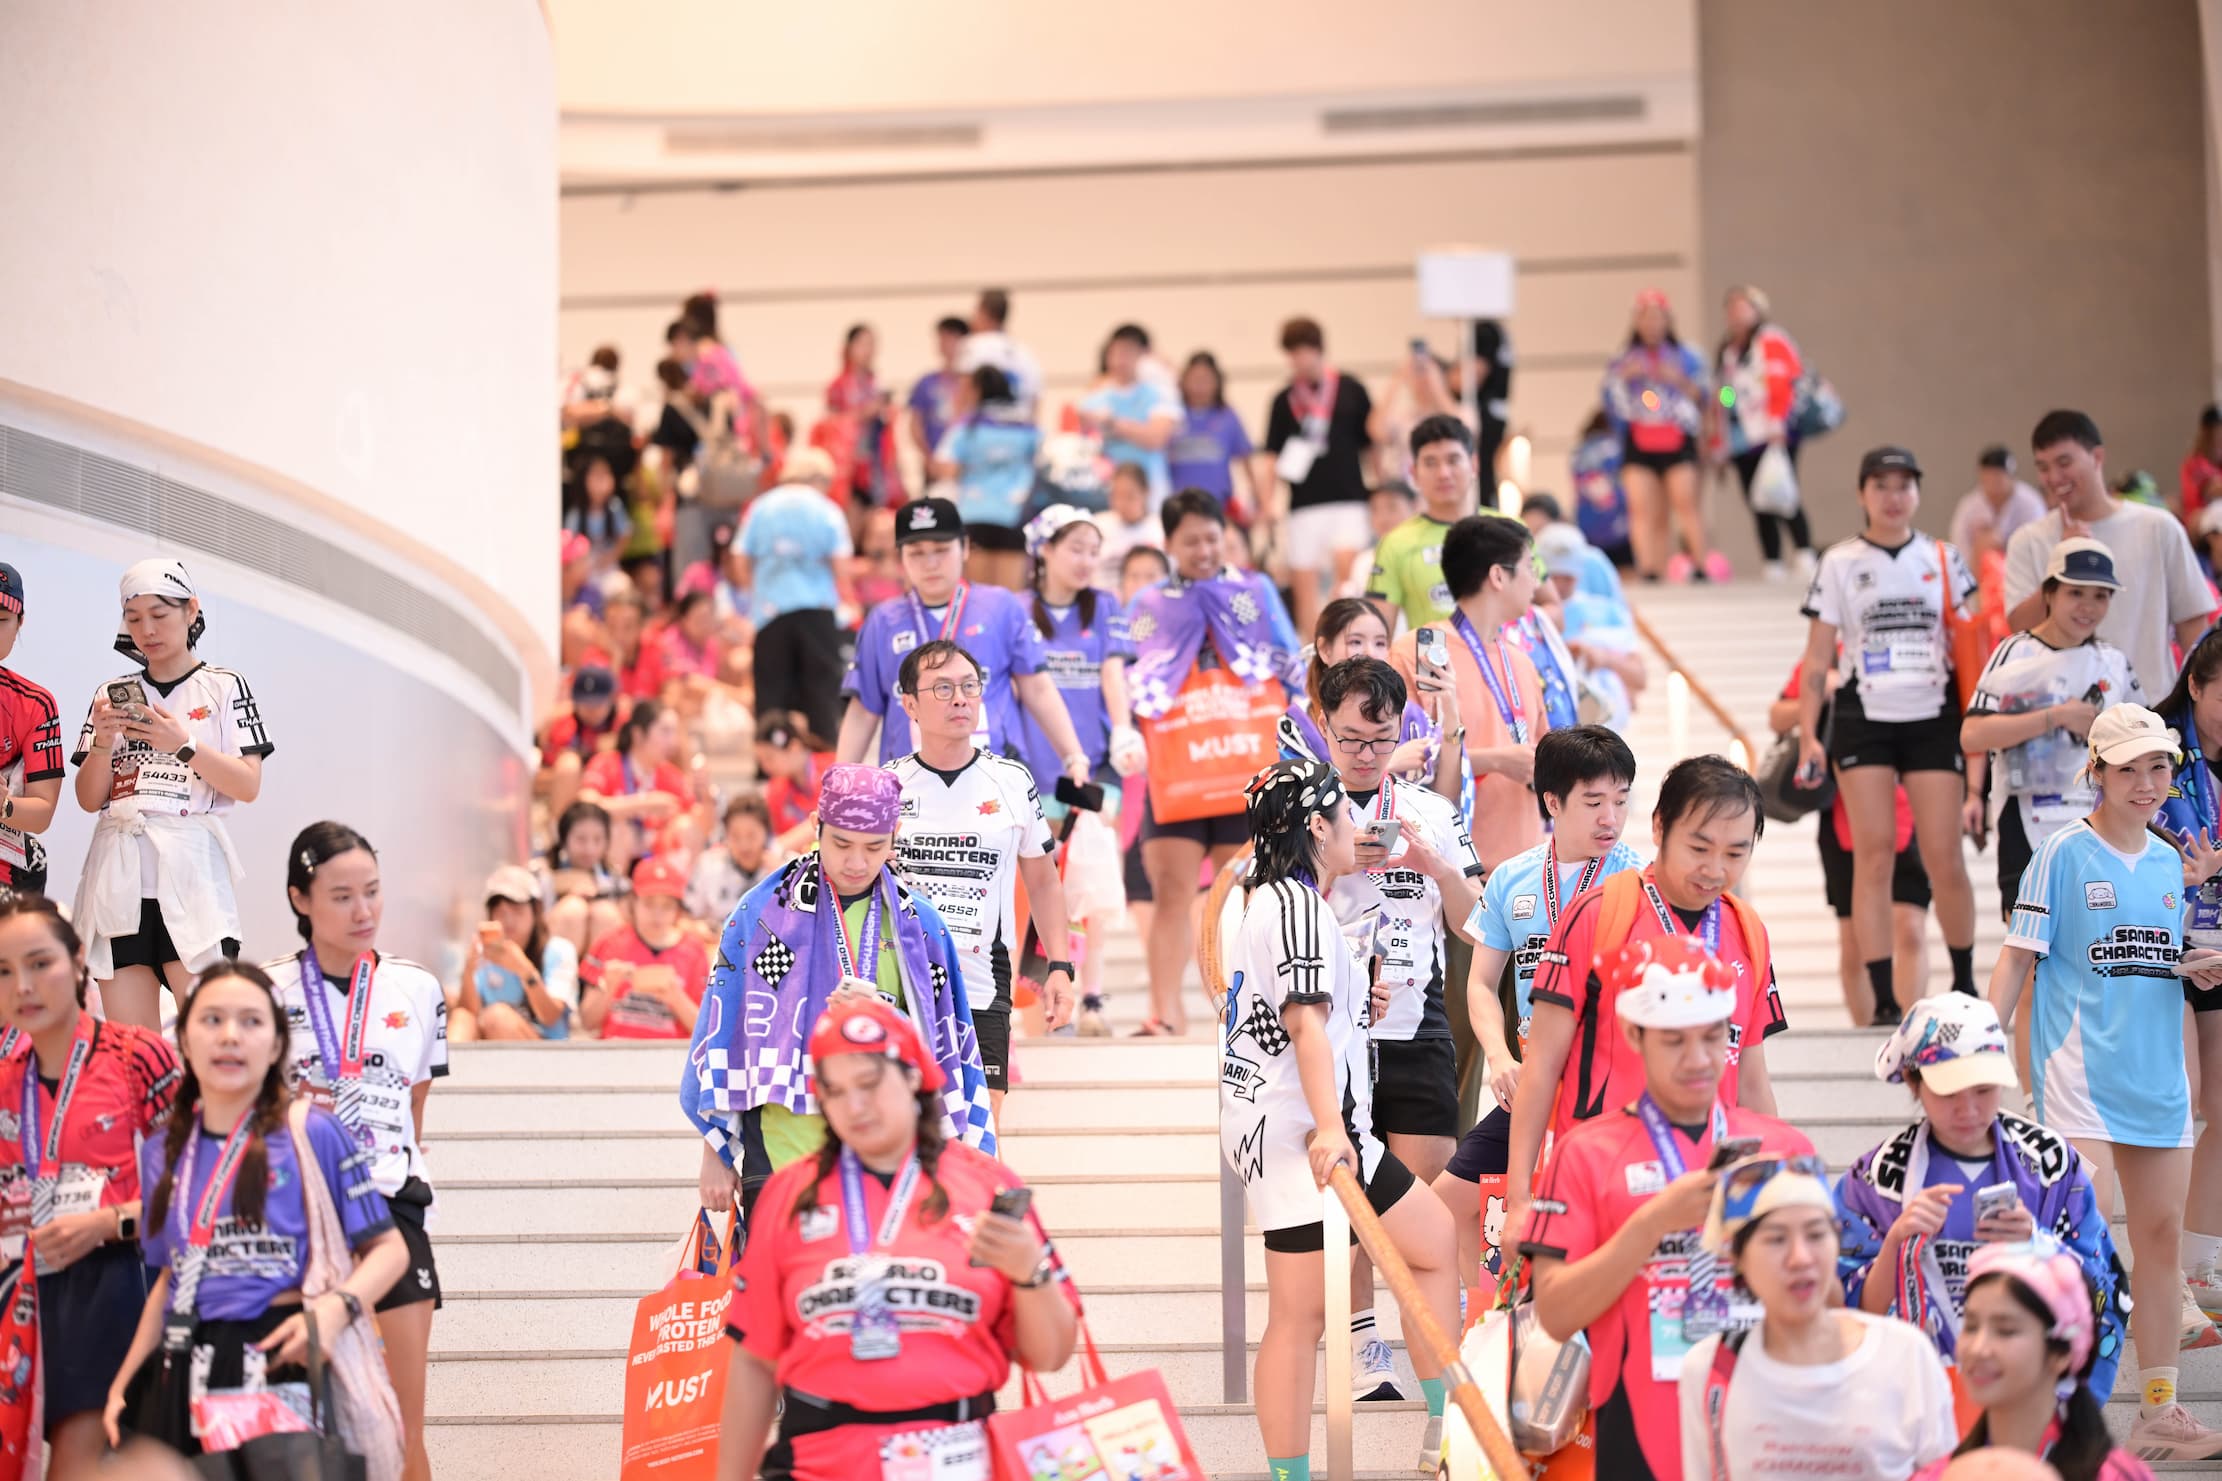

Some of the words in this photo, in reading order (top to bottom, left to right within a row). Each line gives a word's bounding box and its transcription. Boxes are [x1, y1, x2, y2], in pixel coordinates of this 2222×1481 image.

[1188, 734, 1262, 762] MUST
[142, 771, 188, 783] 54433
[913, 835, 978, 848] SANRIO
[937, 903, 979, 917] 45521
[2115, 929, 2170, 945] SANRIO
[831, 1263, 938, 1282] SRIO
[649, 1302, 695, 1332] WHOLE
[700, 1289, 733, 1319] FOOD
[800, 1286, 978, 1318] CHARCTERS
[656, 1314, 721, 1344] PROTEIN
[697, 1333, 717, 1349] THIS
[644, 1369, 713, 1413] MUST
